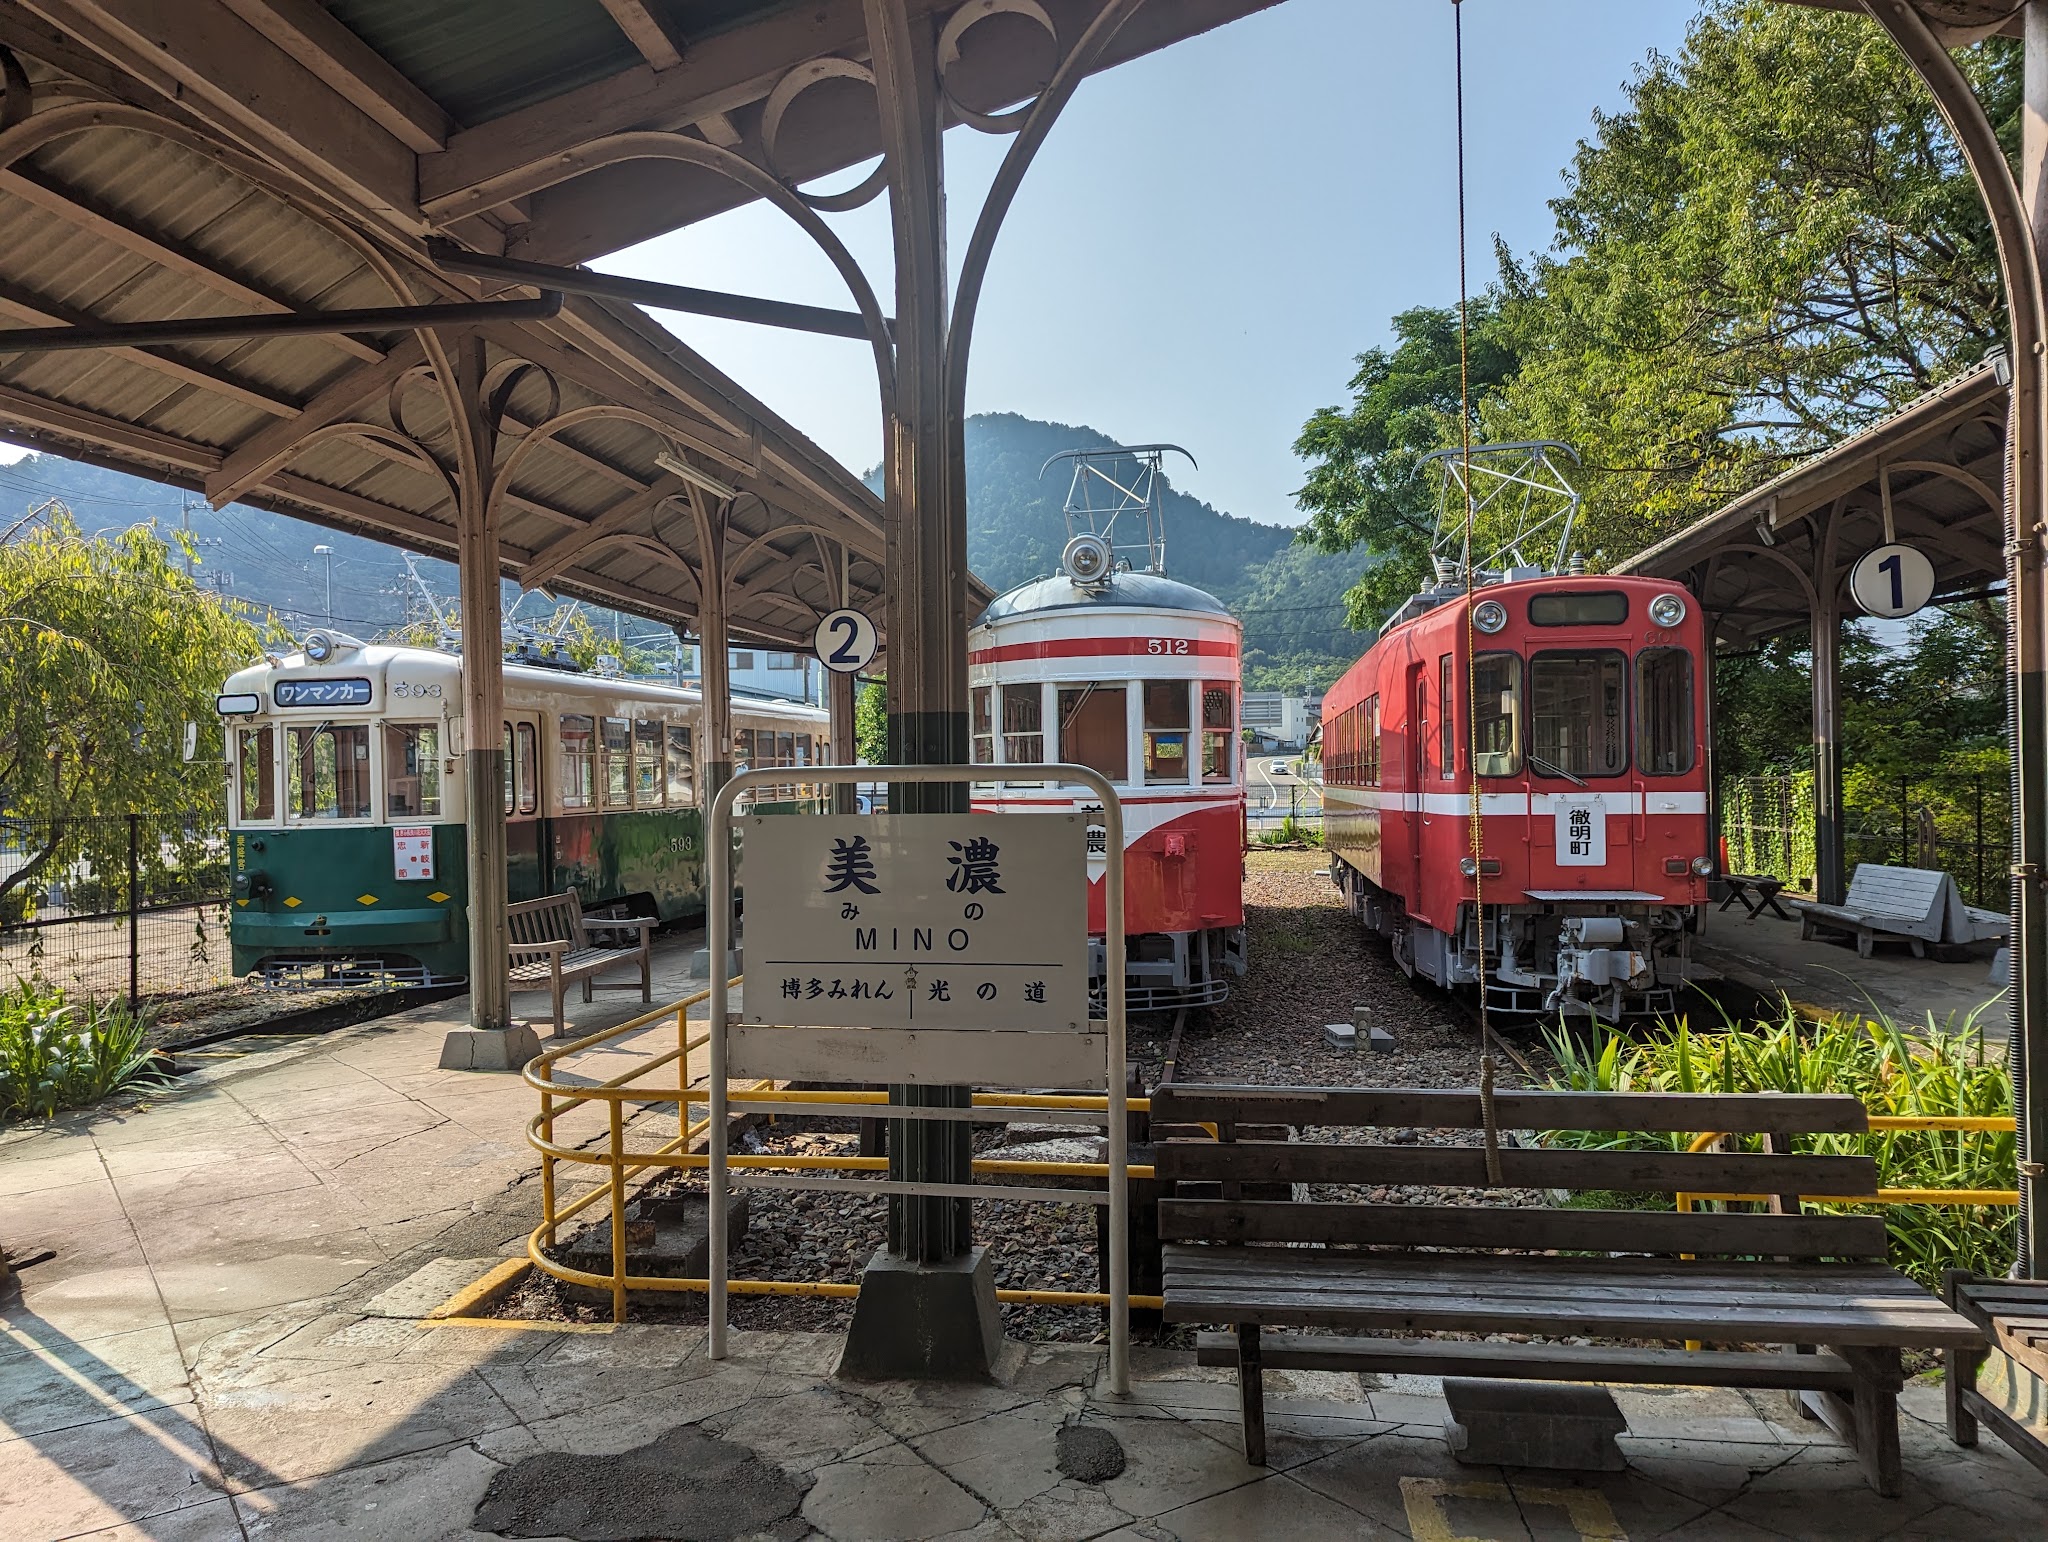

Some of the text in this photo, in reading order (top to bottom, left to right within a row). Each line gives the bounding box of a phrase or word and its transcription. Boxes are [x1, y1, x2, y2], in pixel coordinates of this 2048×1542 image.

[1878, 554, 1904, 609] 1
[828, 615, 860, 664] 2
[1147, 638, 1189, 655] 512
[281, 683, 369, 702] ワンマンカー
[394, 681, 442, 698] 593
[670, 836, 692, 853] 593
[1569, 809, 1592, 856] 徹明町
[823, 835, 1007, 895] 美濃
[855, 927, 970, 951] MINO
[780, 977, 894, 1001] 博多みれん
[927, 979, 1048, 1003] 光の道
